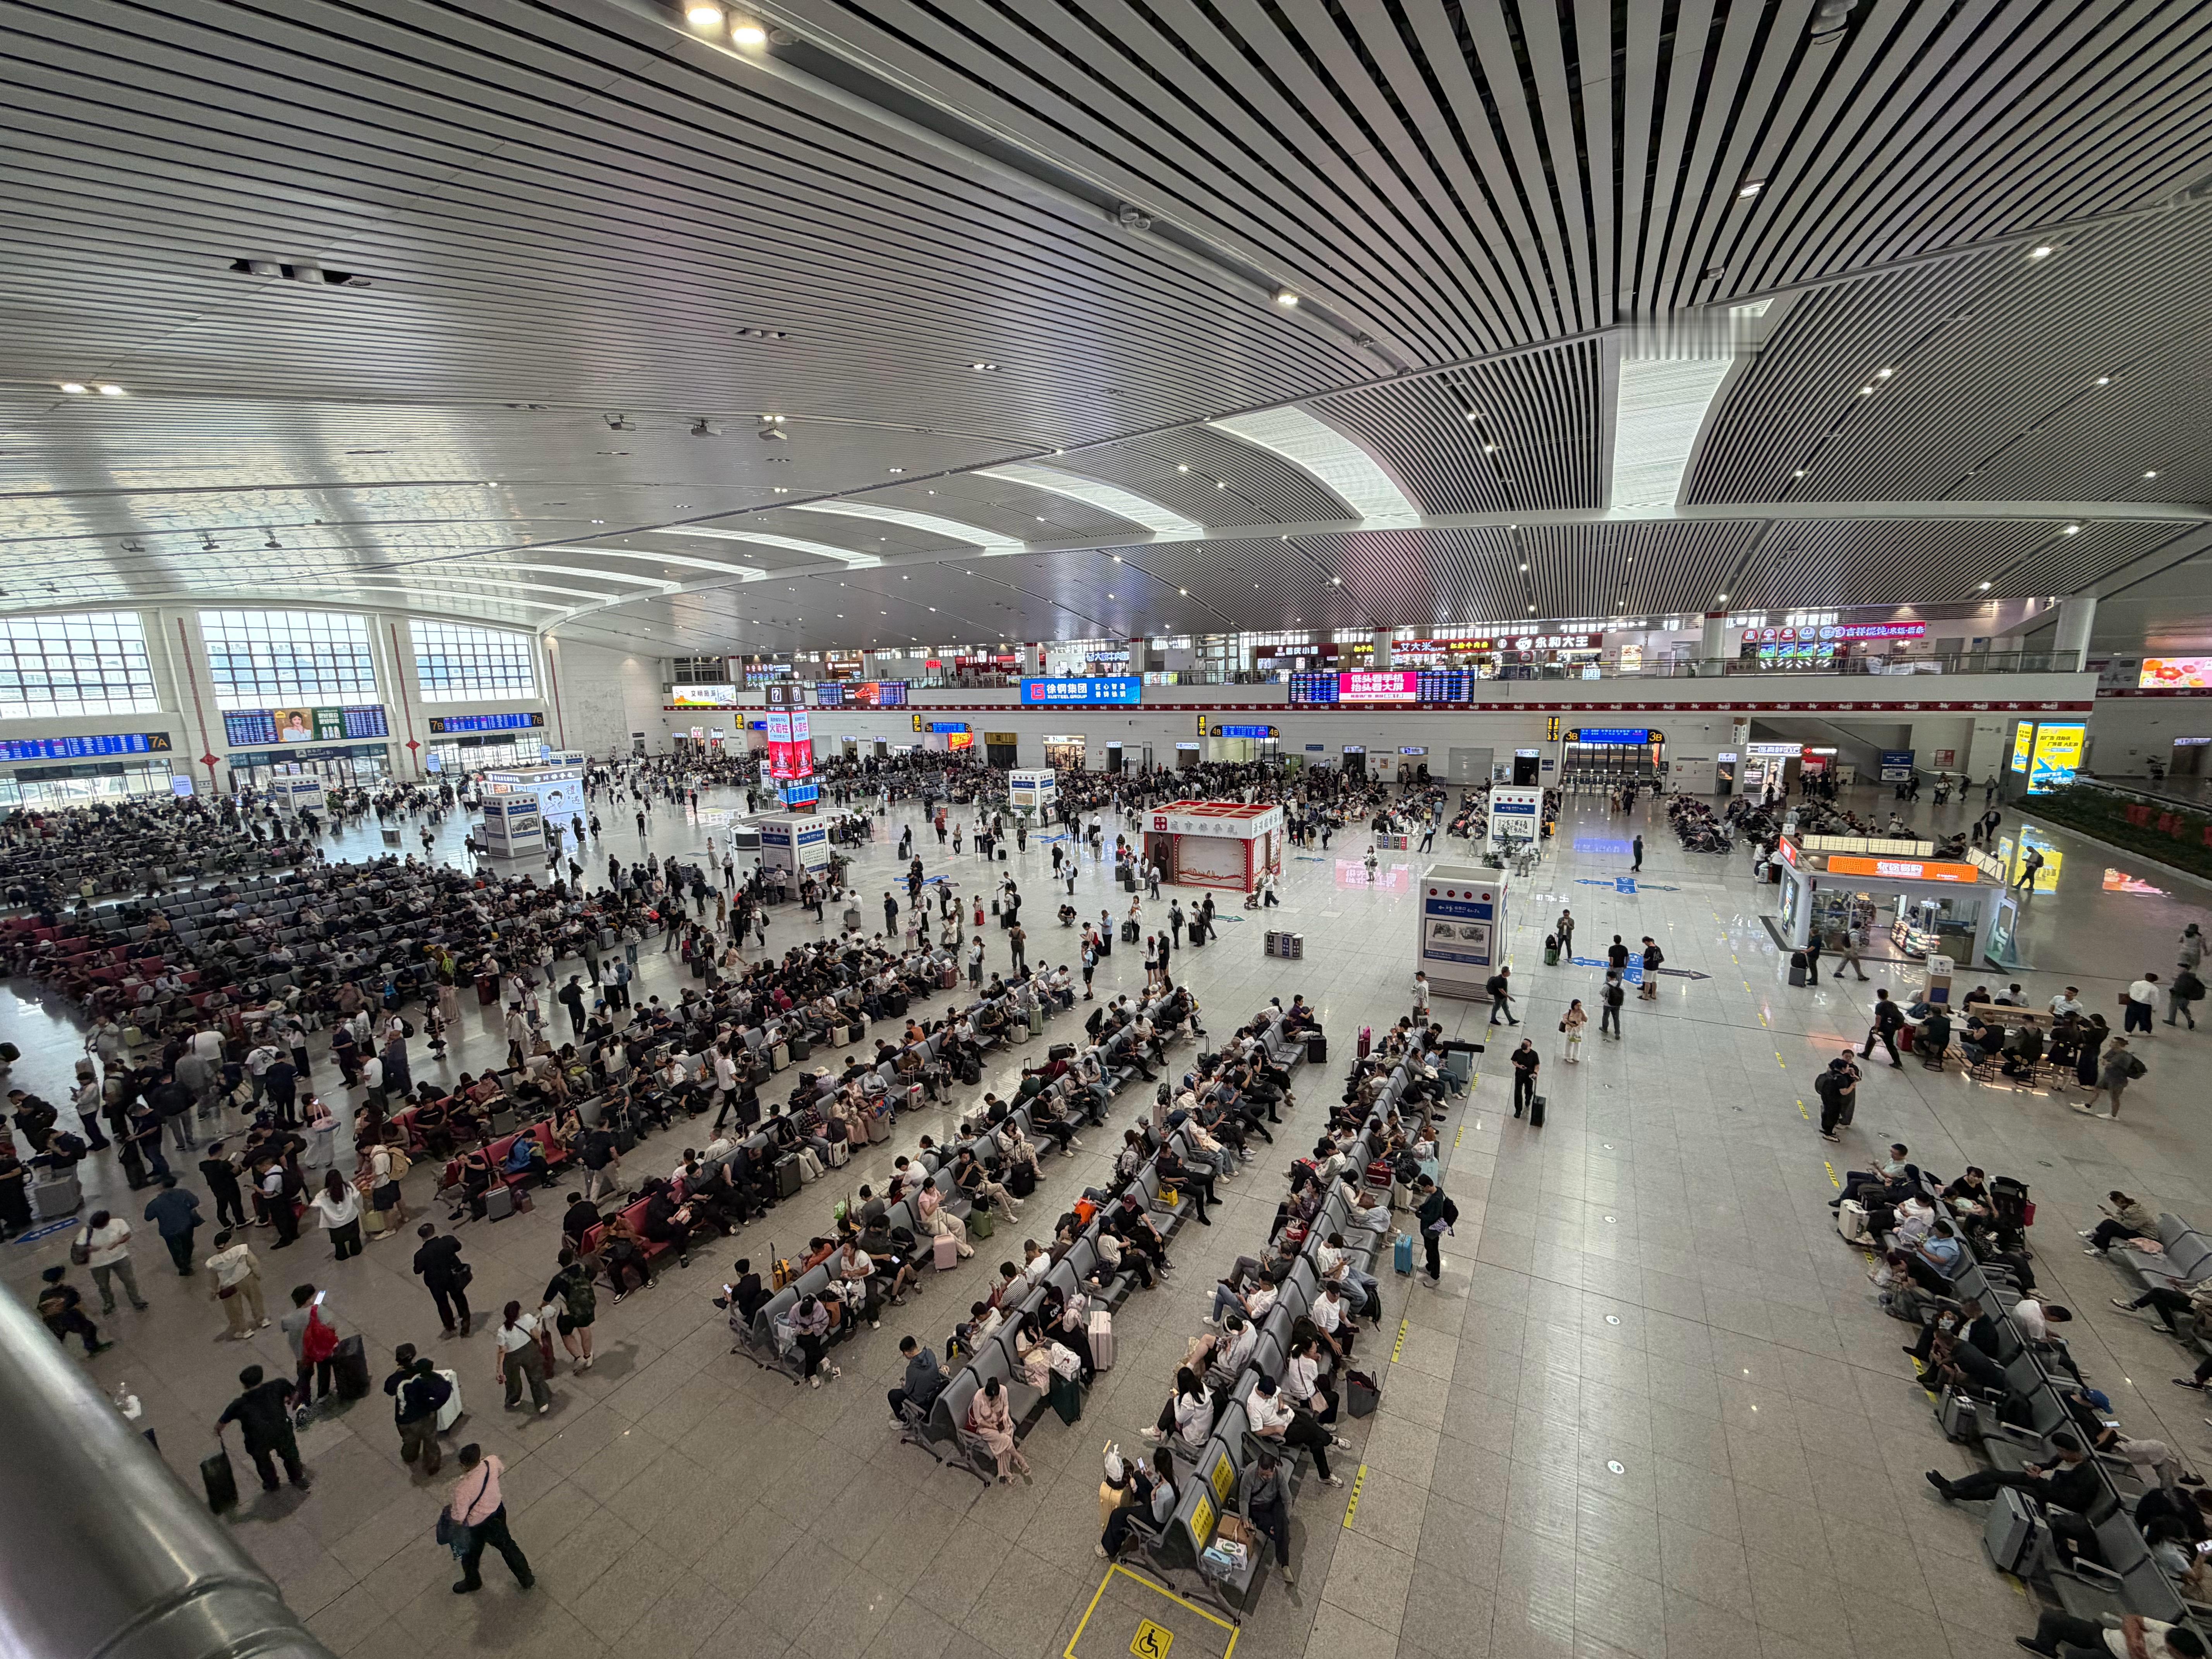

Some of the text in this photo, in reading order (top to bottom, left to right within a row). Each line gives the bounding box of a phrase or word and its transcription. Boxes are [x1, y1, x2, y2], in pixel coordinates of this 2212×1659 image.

[1535, 636, 1589, 648] 永和大王
[1351, 674, 1404, 683] 低头看手机
[1046, 683, 1087, 694] 徐钢集团
[1351, 683, 1404, 692] 抬头看大屏
[531, 715, 543, 725] 7B
[430, 721, 444, 730] 7B
[1566, 731, 1578, 740] 3B
[1649, 732, 1662, 741] 3B
[148, 736, 168, 747] 7A
[1877, 861, 1923, 872] 旅途易购
